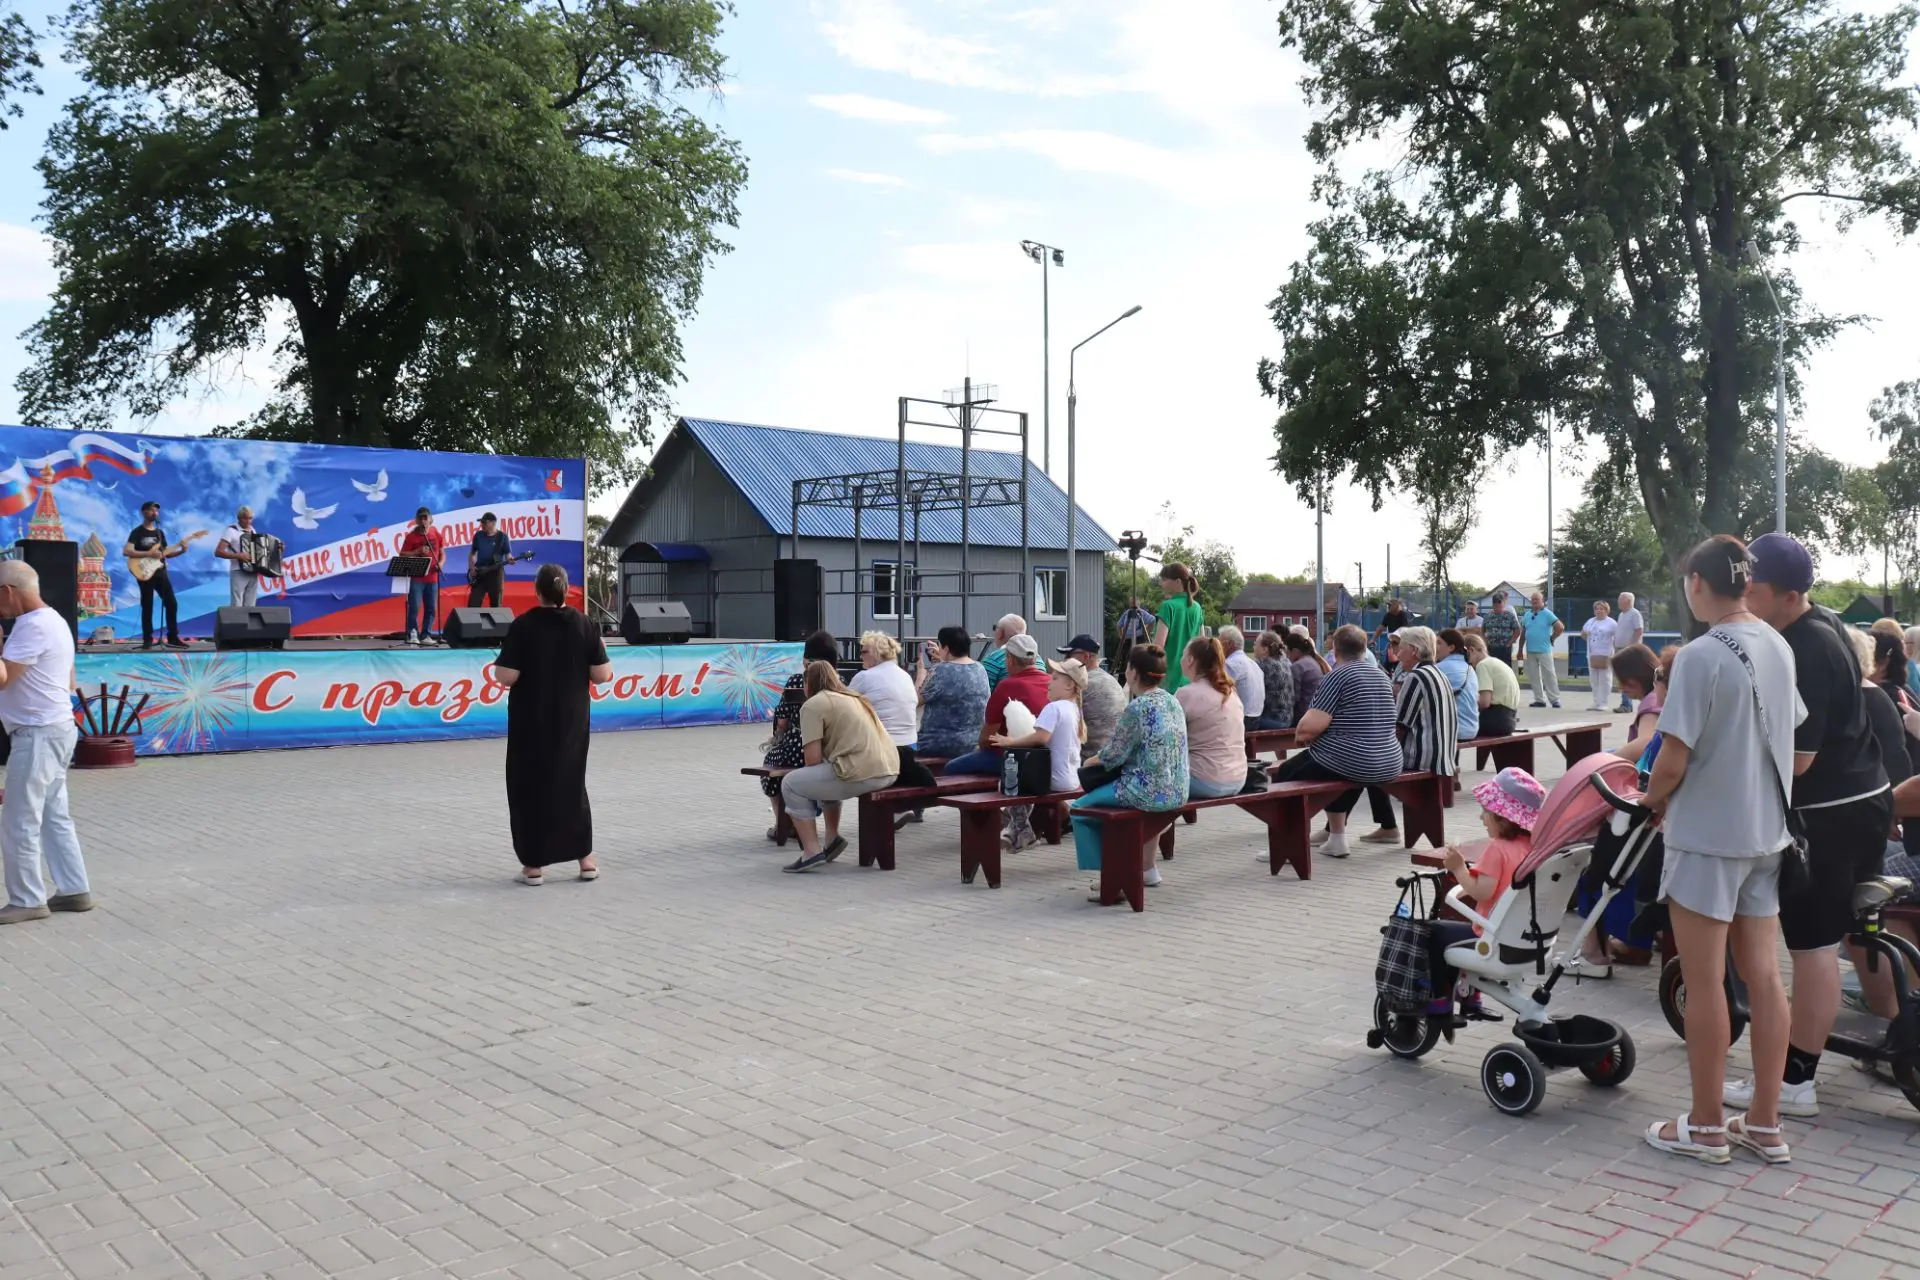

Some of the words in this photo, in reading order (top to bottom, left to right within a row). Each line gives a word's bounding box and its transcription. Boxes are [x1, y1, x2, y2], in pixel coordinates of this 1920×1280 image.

[340, 527, 389, 568] нет
[500, 504, 561, 540] моей!
[252, 669, 297, 712] С
